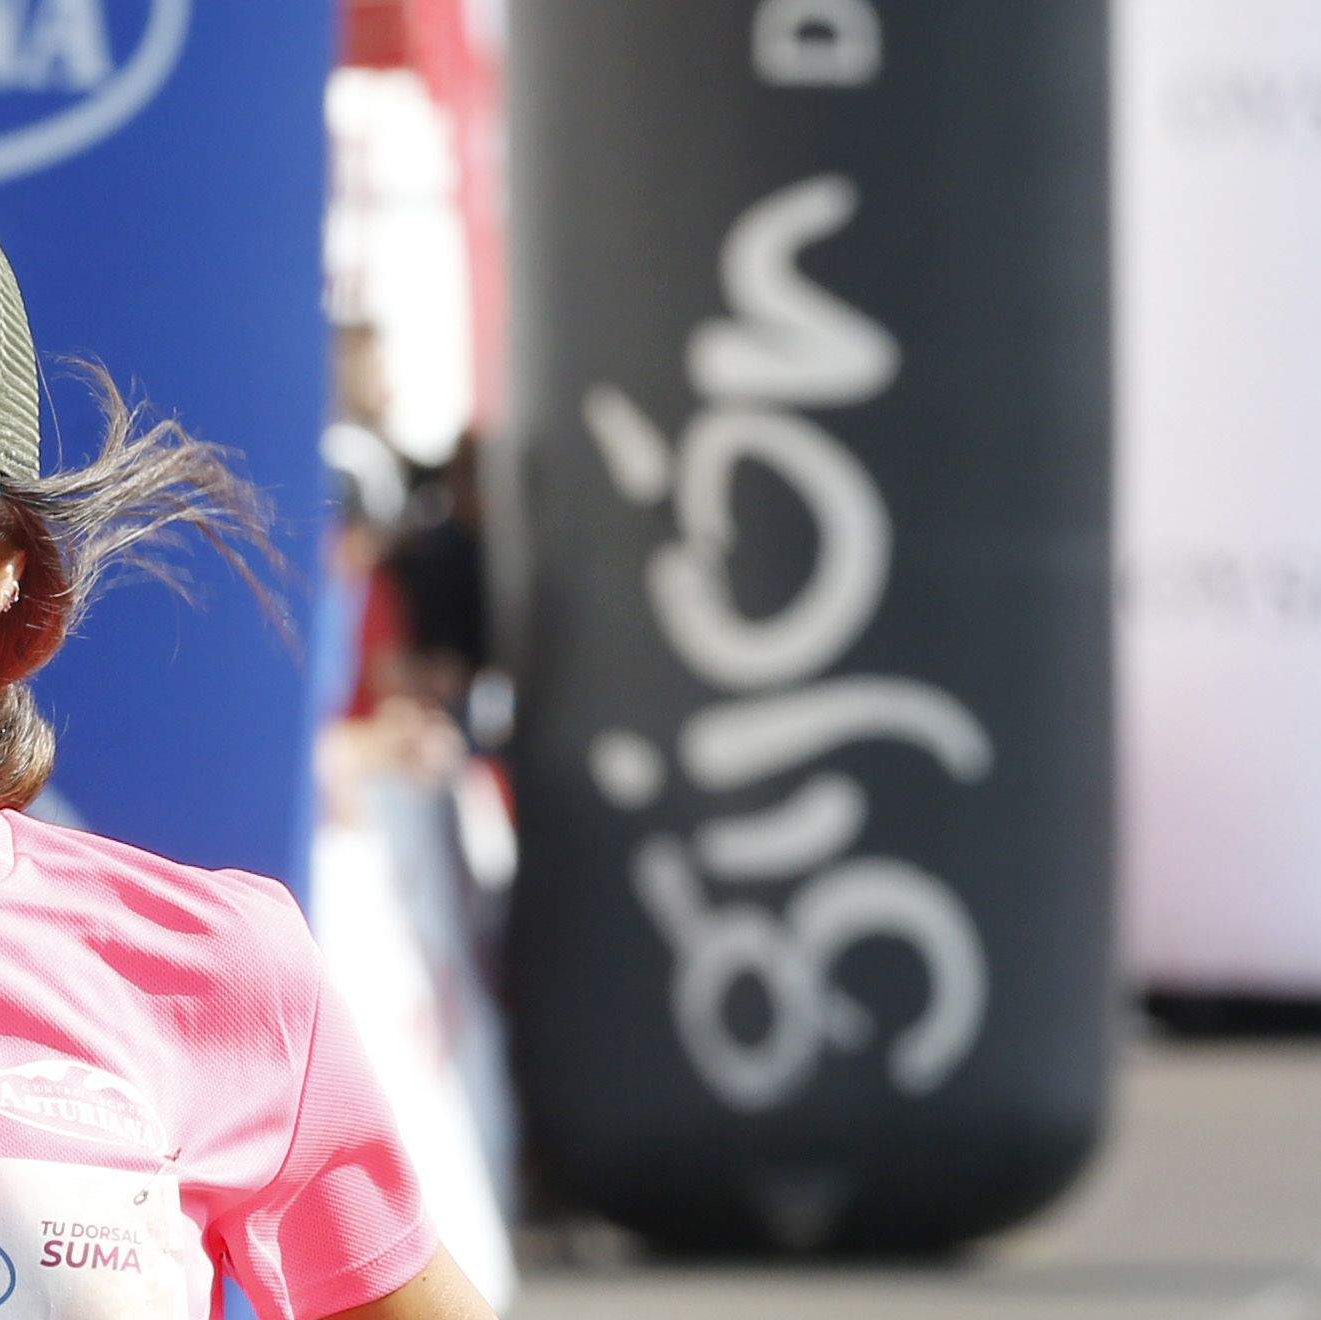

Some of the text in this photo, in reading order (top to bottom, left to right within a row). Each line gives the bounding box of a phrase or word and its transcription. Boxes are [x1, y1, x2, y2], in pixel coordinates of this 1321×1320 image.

[583, 171, 993, 1112] gijón
[40, 1220, 143, 1245] TU DORSAL
[39, 1240, 143, 1275] SUMA
